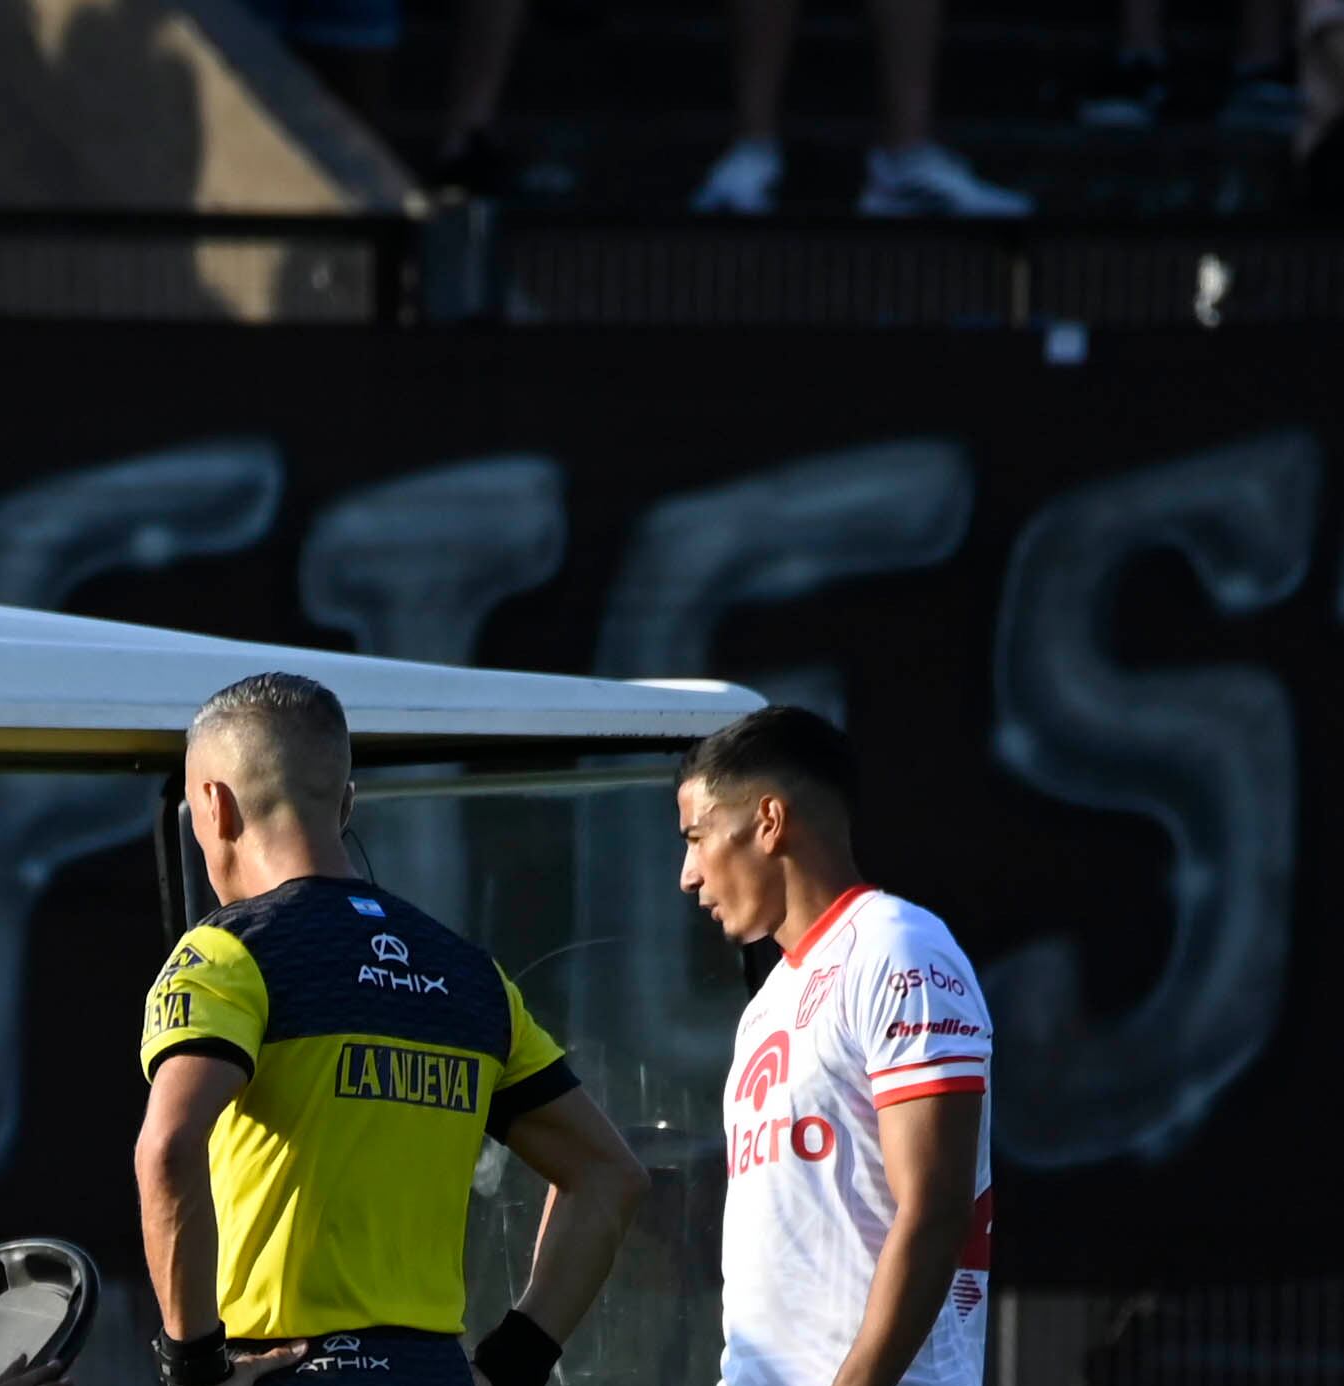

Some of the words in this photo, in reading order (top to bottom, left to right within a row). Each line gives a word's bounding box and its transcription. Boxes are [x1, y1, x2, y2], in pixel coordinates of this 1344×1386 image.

[357, 964, 449, 994] ATHIX
[340, 1047, 382, 1096] LA
[389, 1050, 471, 1110] NUEVA
[295, 1356, 391, 1373] ATHIX
